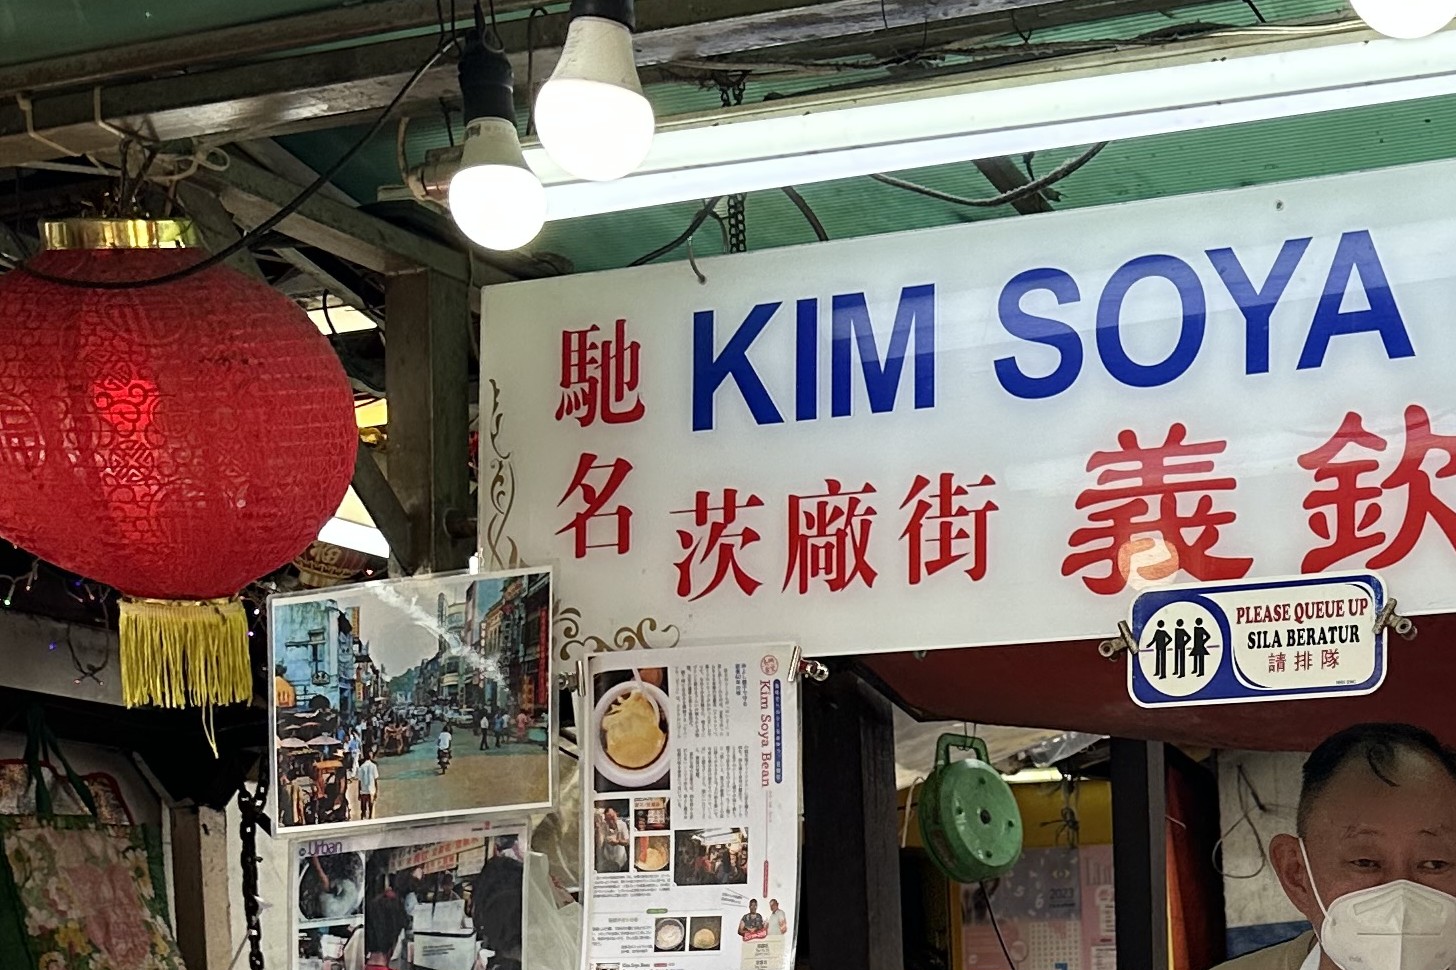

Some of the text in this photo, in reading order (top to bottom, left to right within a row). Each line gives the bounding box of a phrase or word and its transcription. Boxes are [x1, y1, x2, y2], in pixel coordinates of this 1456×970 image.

[692, 284, 936, 431] KIM
[994, 231, 1415, 399] SOYA
[555, 318, 646, 560] 馳名
[671, 474, 999, 602] 茨廠街
[1236, 598, 1368, 624] PLEASE QUEUE UP
[1248, 625, 1360, 649] SILA BERATUR
[1268, 649, 1340, 672] 請排隊
[760, 680, 771, 710] Kim
[758, 714, 771, 747] Soya
[761, 752, 772, 787] Bean
